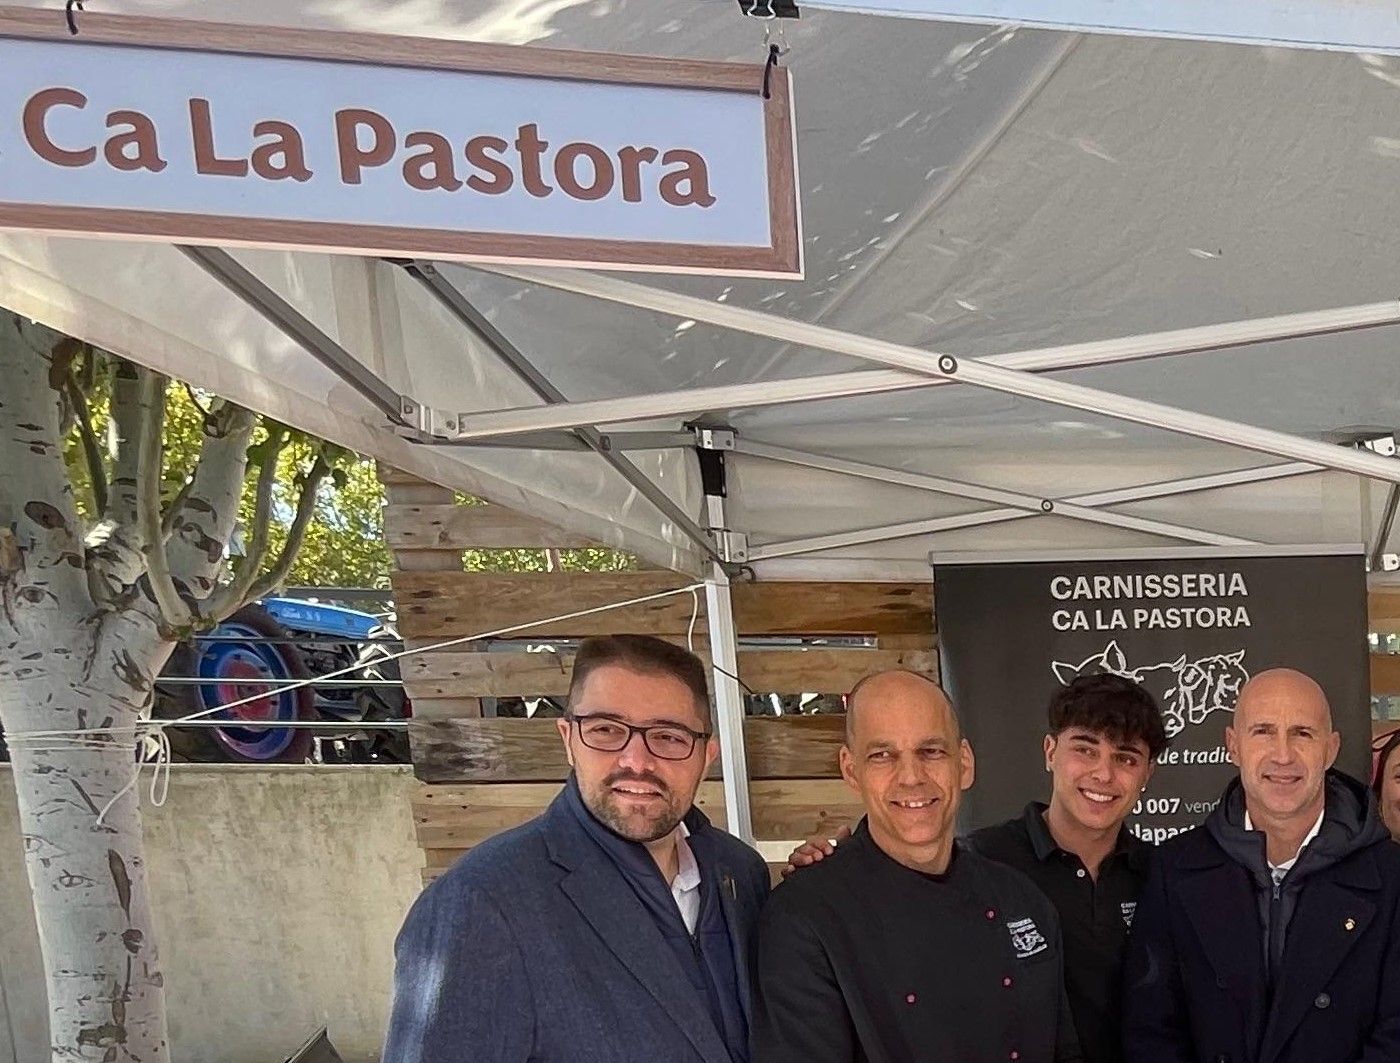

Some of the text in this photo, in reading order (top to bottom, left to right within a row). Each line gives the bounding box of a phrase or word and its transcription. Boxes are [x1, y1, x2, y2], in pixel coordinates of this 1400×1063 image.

[22, 86, 718, 208] Ca La Pastora
[1050, 573, 1249, 600] CARNISSERIA
[1052, 606, 1252, 631] CA LA PASTORA
[1156, 747, 1179, 765] de
[1146, 797, 1181, 815] 007
